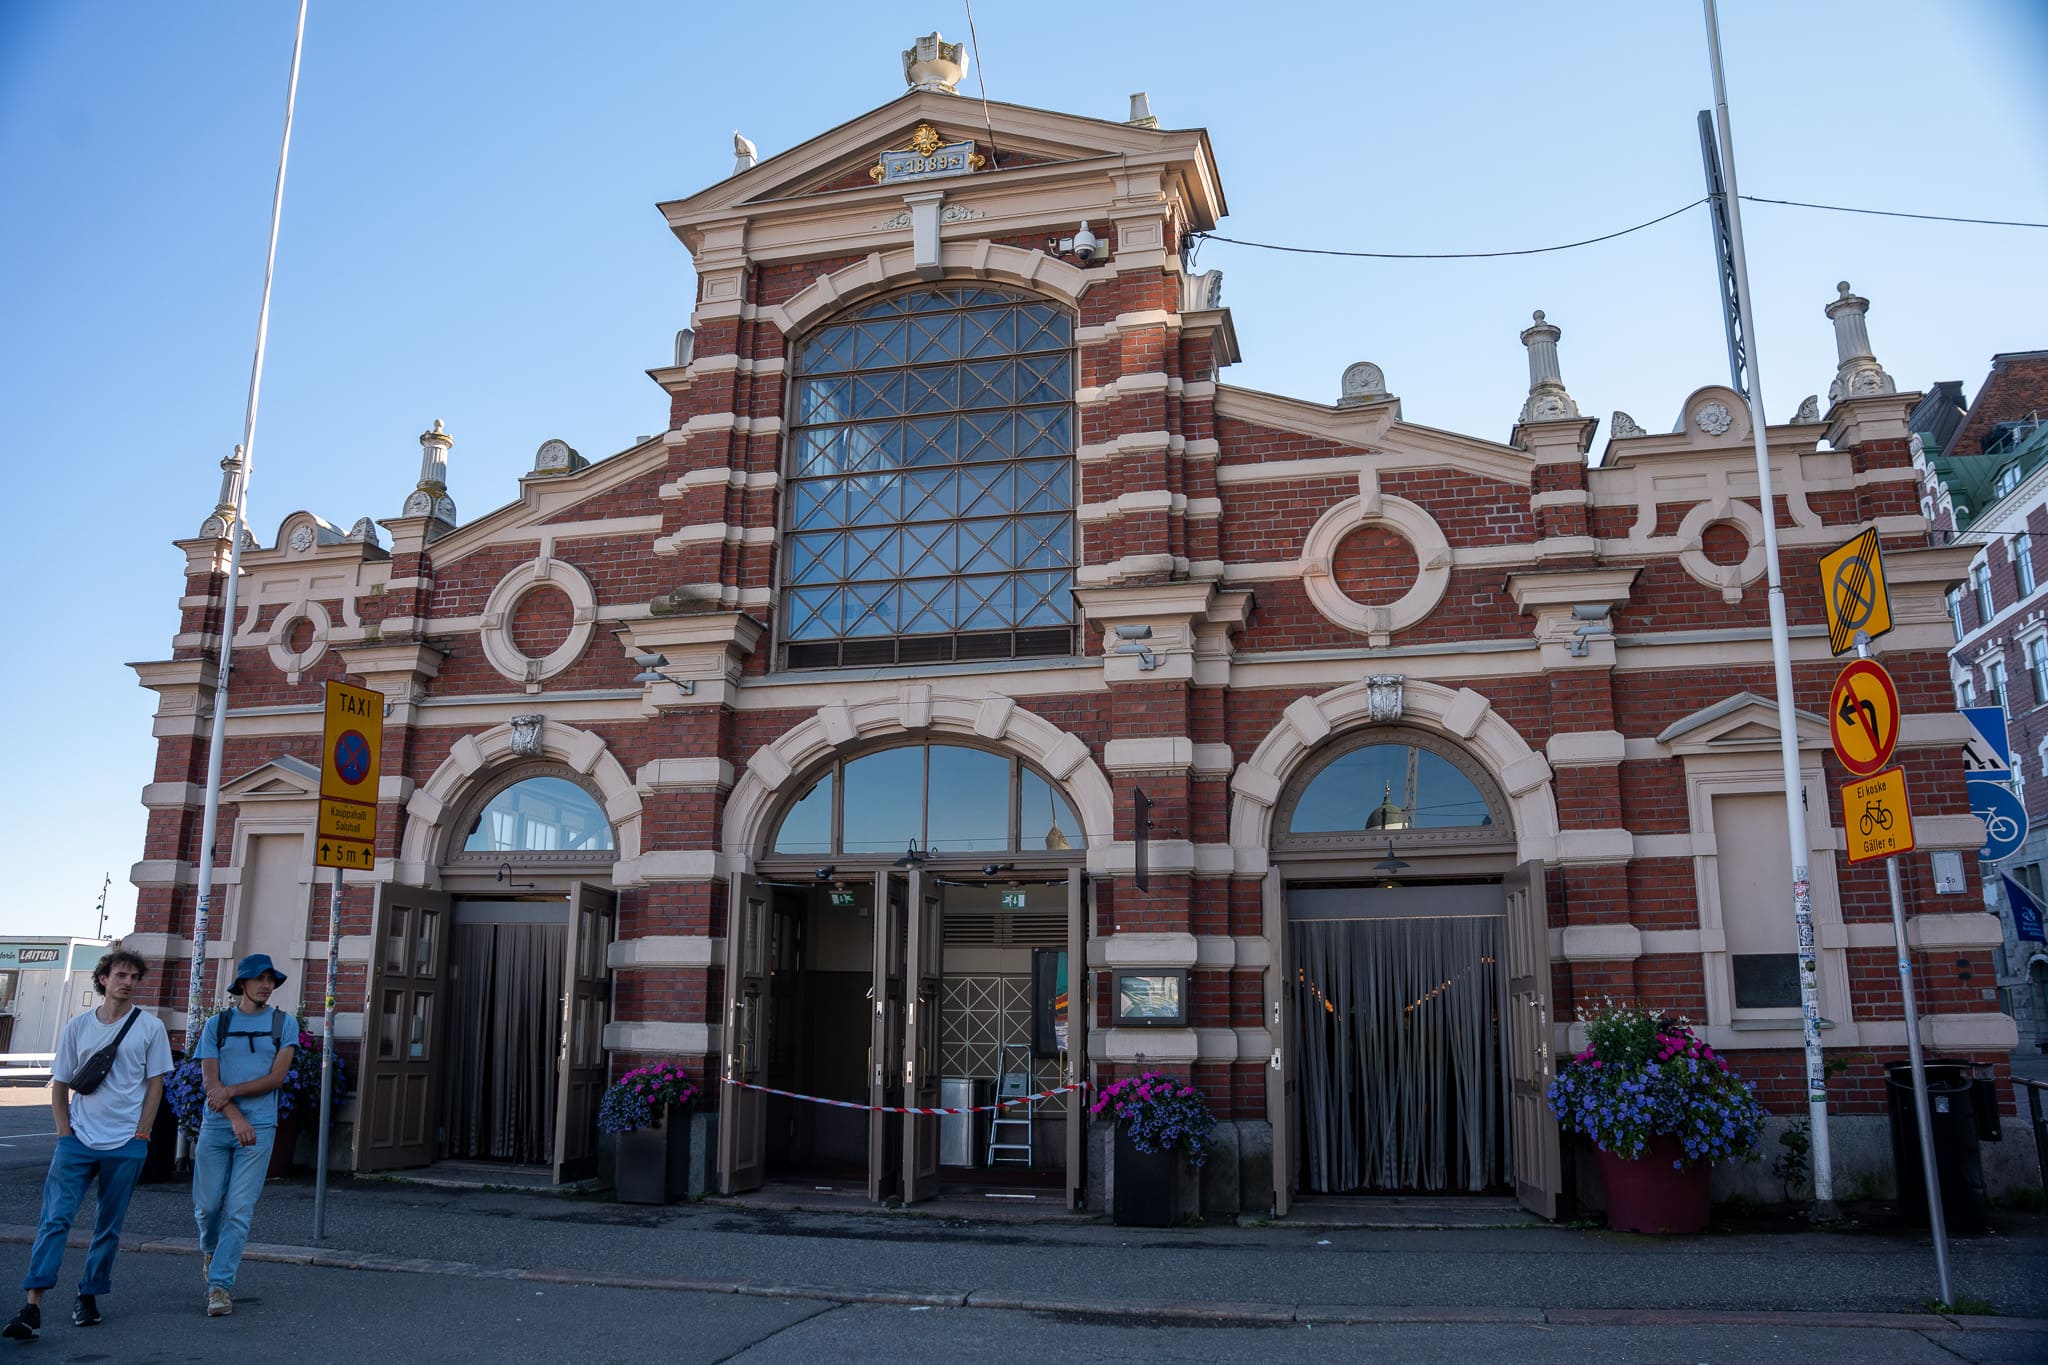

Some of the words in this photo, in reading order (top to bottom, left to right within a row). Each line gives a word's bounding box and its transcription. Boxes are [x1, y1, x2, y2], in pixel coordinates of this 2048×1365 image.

[906, 155, 948, 173] 1889
[340, 693, 371, 718] TAXI
[1857, 786, 1865, 799] Ei
[1866, 781, 1887, 796] koske
[1863, 838, 1886, 852] Gäller
[1888, 834, 1896, 849] ej
[336, 845, 344, 861] 5
[346, 850, 356, 863] m
[20, 950, 58, 961] LAITURI
